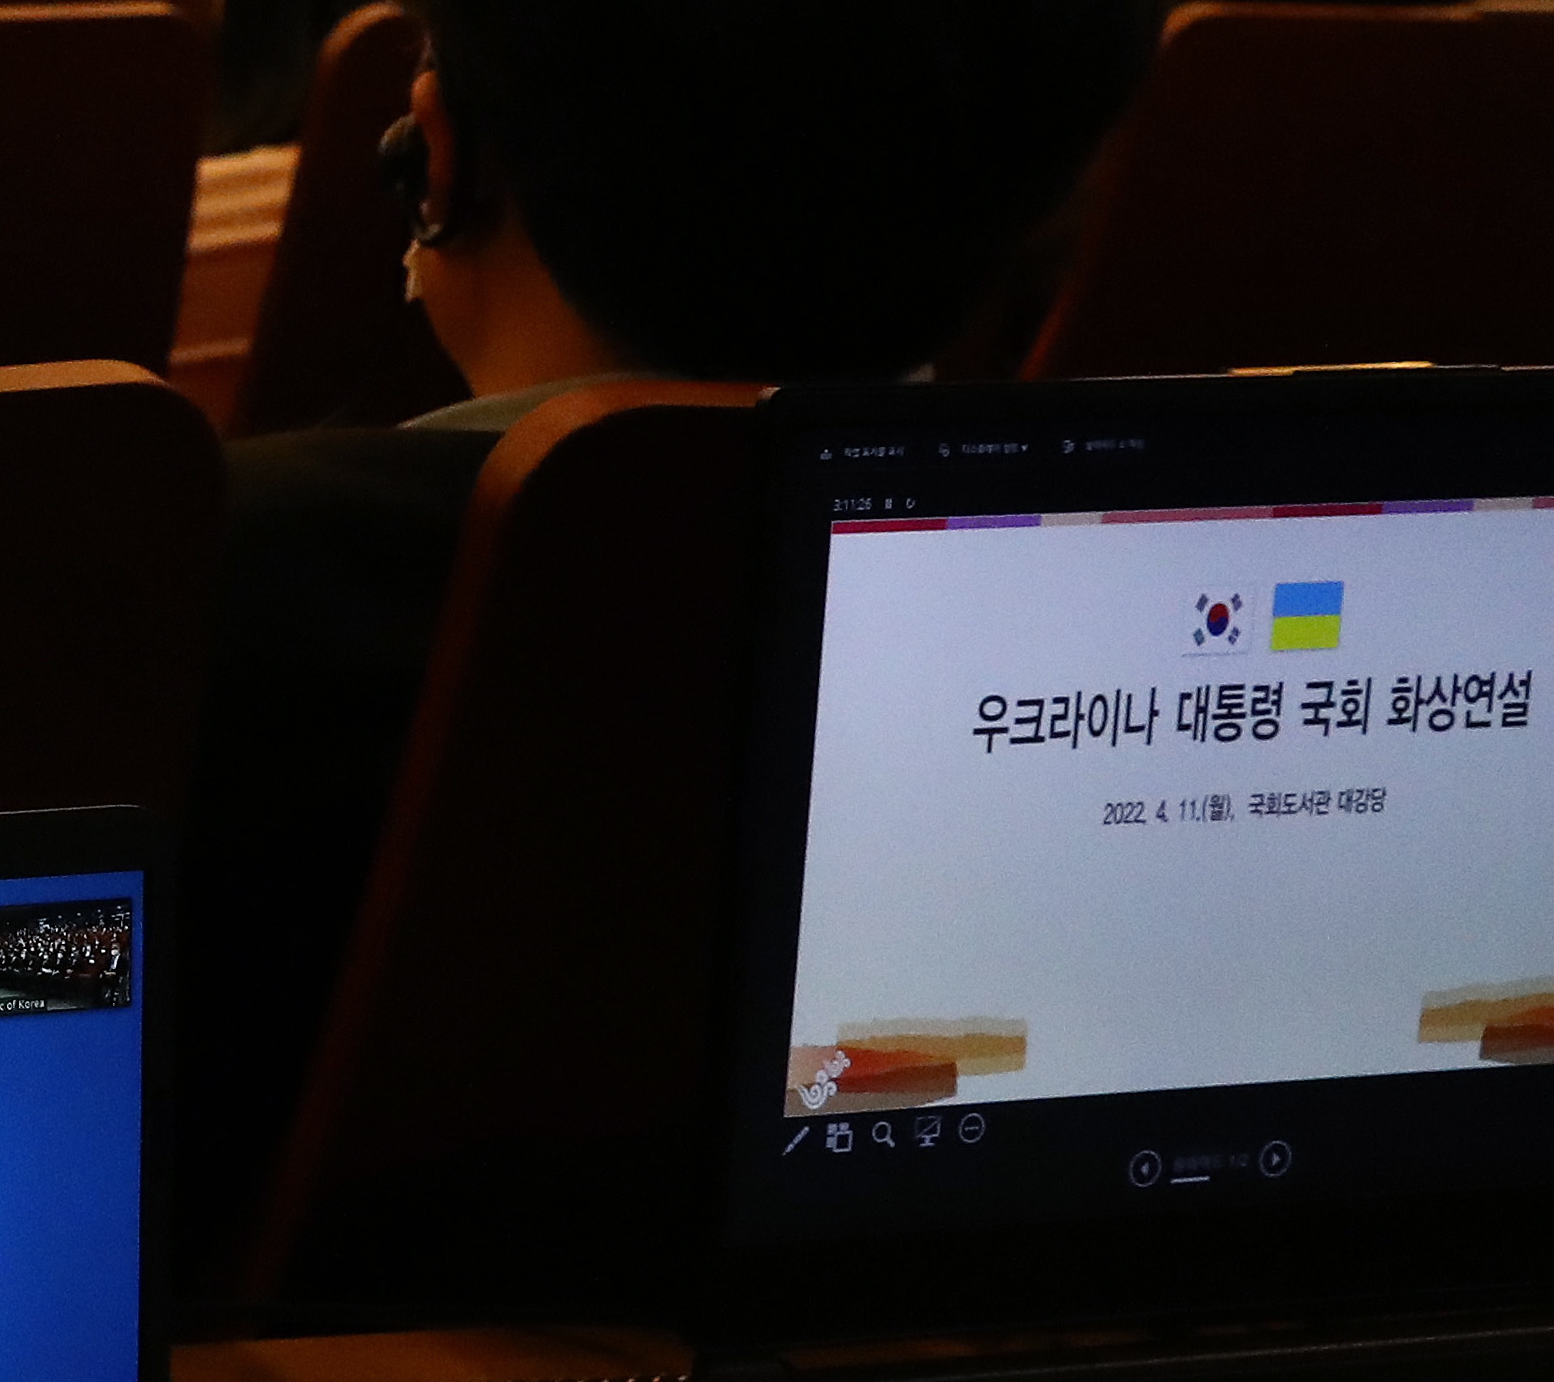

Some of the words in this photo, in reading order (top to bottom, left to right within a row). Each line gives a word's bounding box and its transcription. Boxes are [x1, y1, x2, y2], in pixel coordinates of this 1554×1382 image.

[972, 687, 1159, 753] 우크라이나
[1176, 681, 1284, 744] 대통령
[1300, 678, 1372, 736] 국회
[1386, 670, 1533, 733] 화상연설
[1248, 789, 1331, 817] 국회도서관
[1337, 787, 1387, 814] 대강당
[7, 1000, 16, 1011] of
[19, 1000, 45, 1009] Korea
